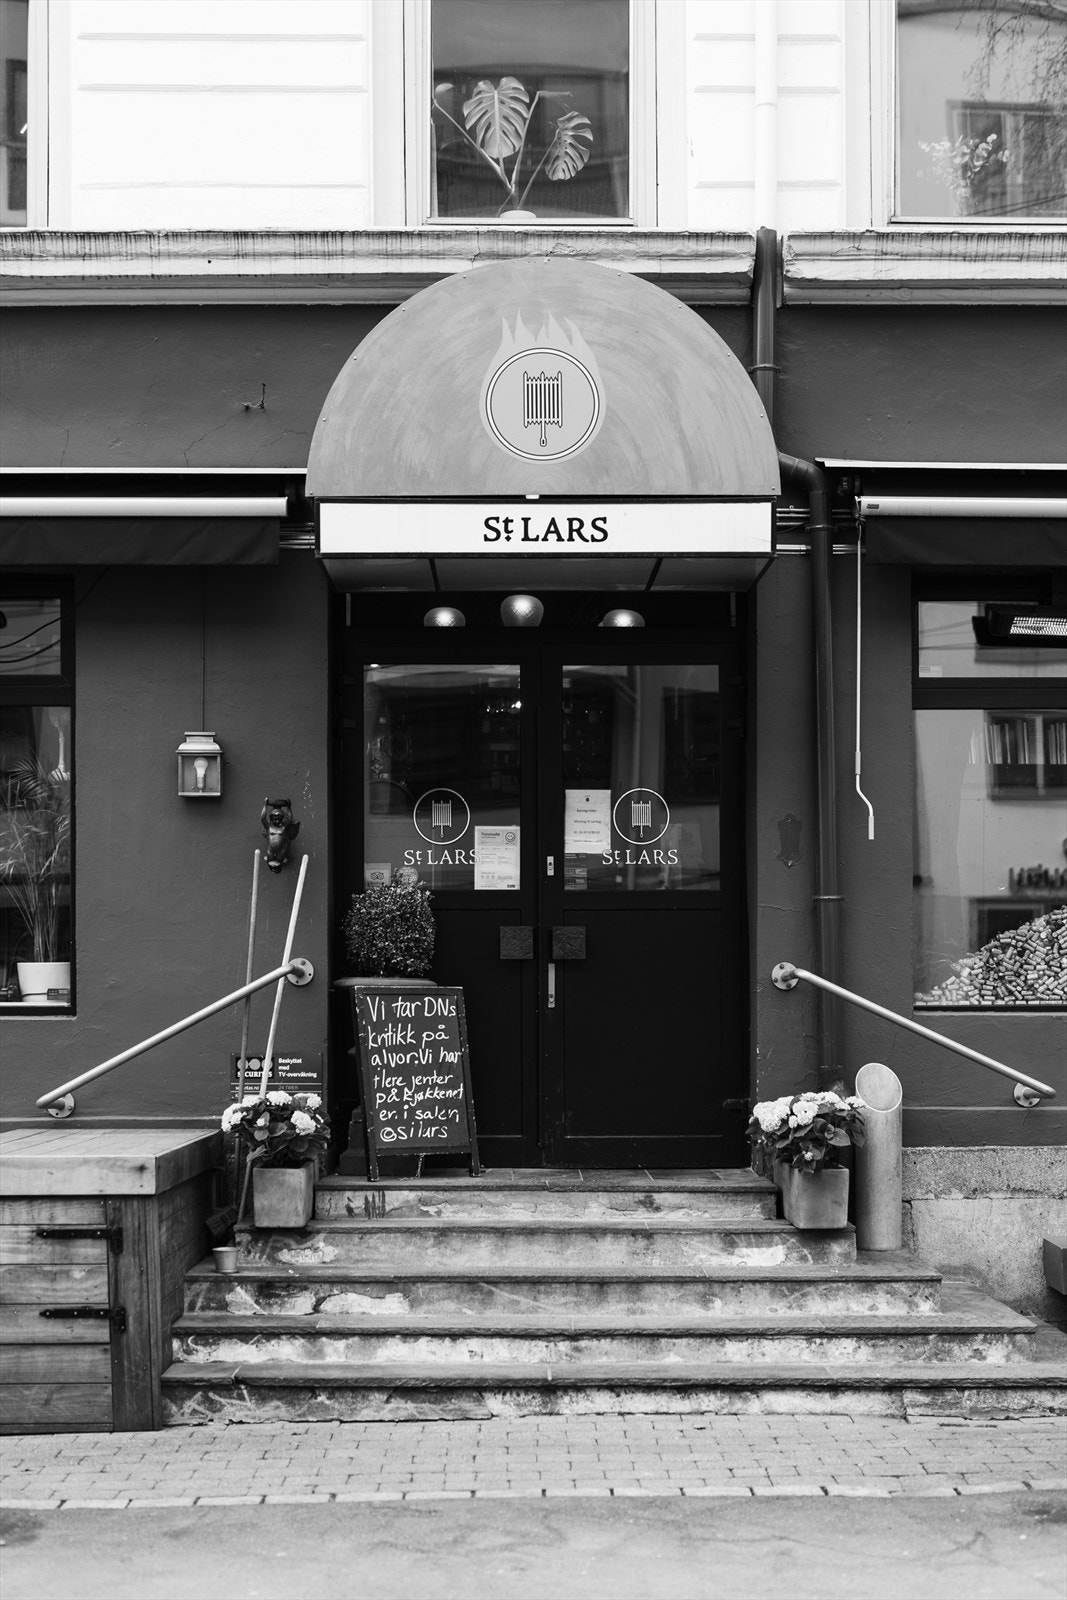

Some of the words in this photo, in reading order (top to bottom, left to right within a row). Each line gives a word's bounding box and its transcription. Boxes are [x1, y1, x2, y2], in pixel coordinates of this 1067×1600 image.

[521, 517, 608, 542] LARS
[427, 849, 481, 865] LARS
[625, 849, 678, 865] LARS
[367, 996, 385, 1022] Vi
[392, 996, 421, 1018] tar
[424, 997, 457, 1017] DNs
[367, 1023, 416, 1049] kritikk
[422, 1024, 449, 1049] på
[419, 1049, 432, 1064] Vi
[439, 1047, 462, 1063] har
[411, 1070, 453, 1091] jenter
[376, 1089, 400, 1108] på
[403, 1105, 408, 1119] i
